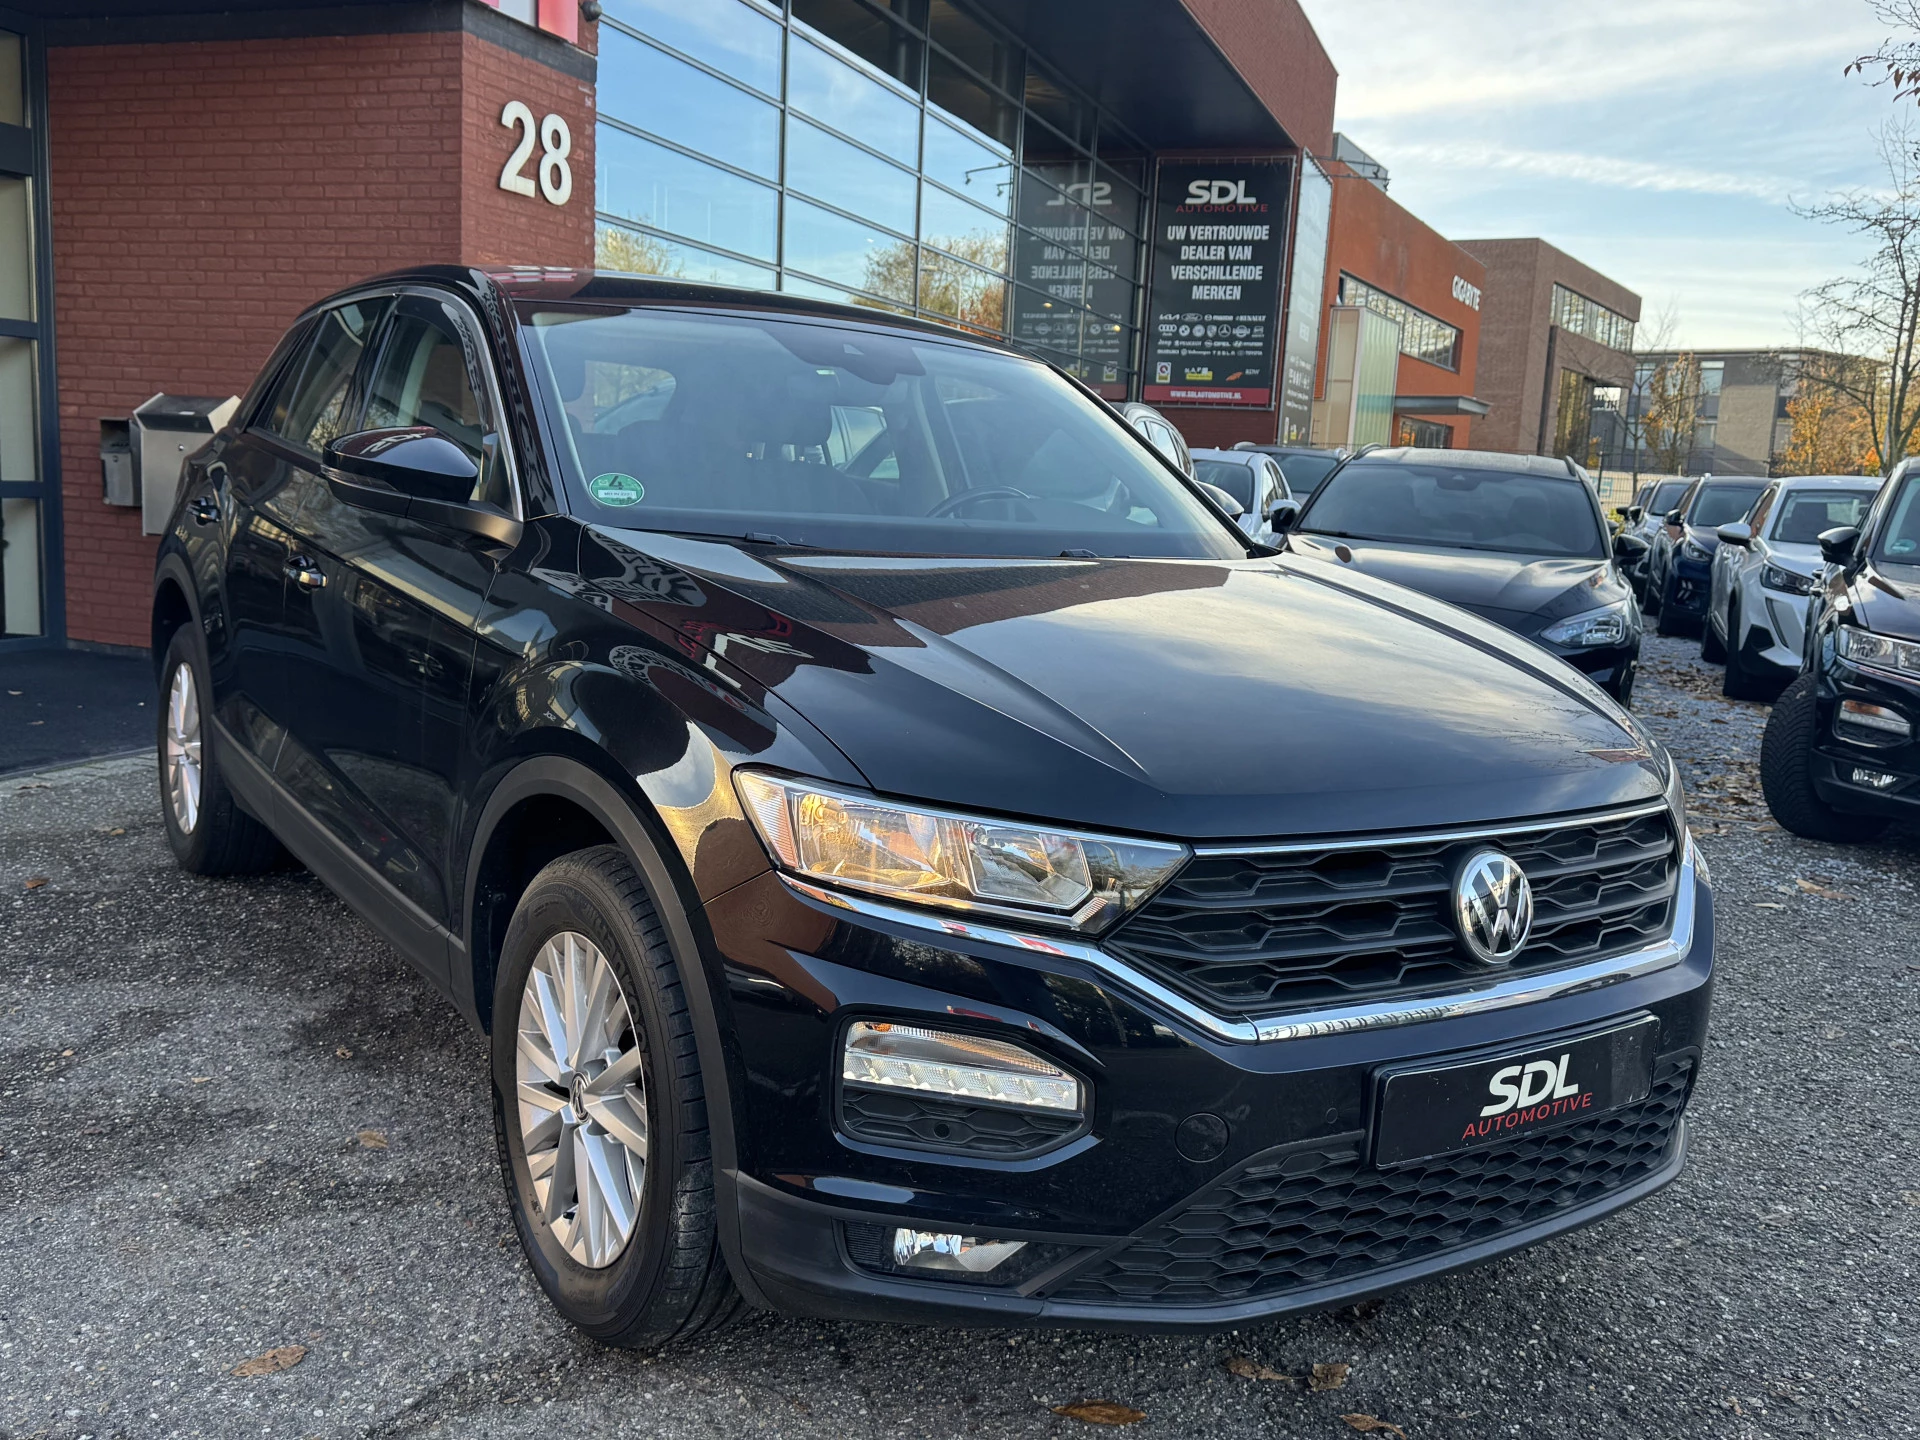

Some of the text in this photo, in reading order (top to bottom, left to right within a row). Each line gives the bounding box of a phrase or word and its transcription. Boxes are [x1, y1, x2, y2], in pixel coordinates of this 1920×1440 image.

[499, 100, 572, 206] 28
[1184, 179, 1257, 204] SDL
[1175, 203, 1269, 213] AUTOMOTIVE
[1167, 225, 1270, 241] UW VERTROUWDE
[1180, 245, 1253, 261] DEALER VAN
[1170, 265, 1264, 281] VERSCHILLENDE
[1191, 285, 1242, 300] MERKEN
[1479, 1053, 1579, 1118] SDL
[1461, 1092, 1593, 1140] AUTOMOTIVE
